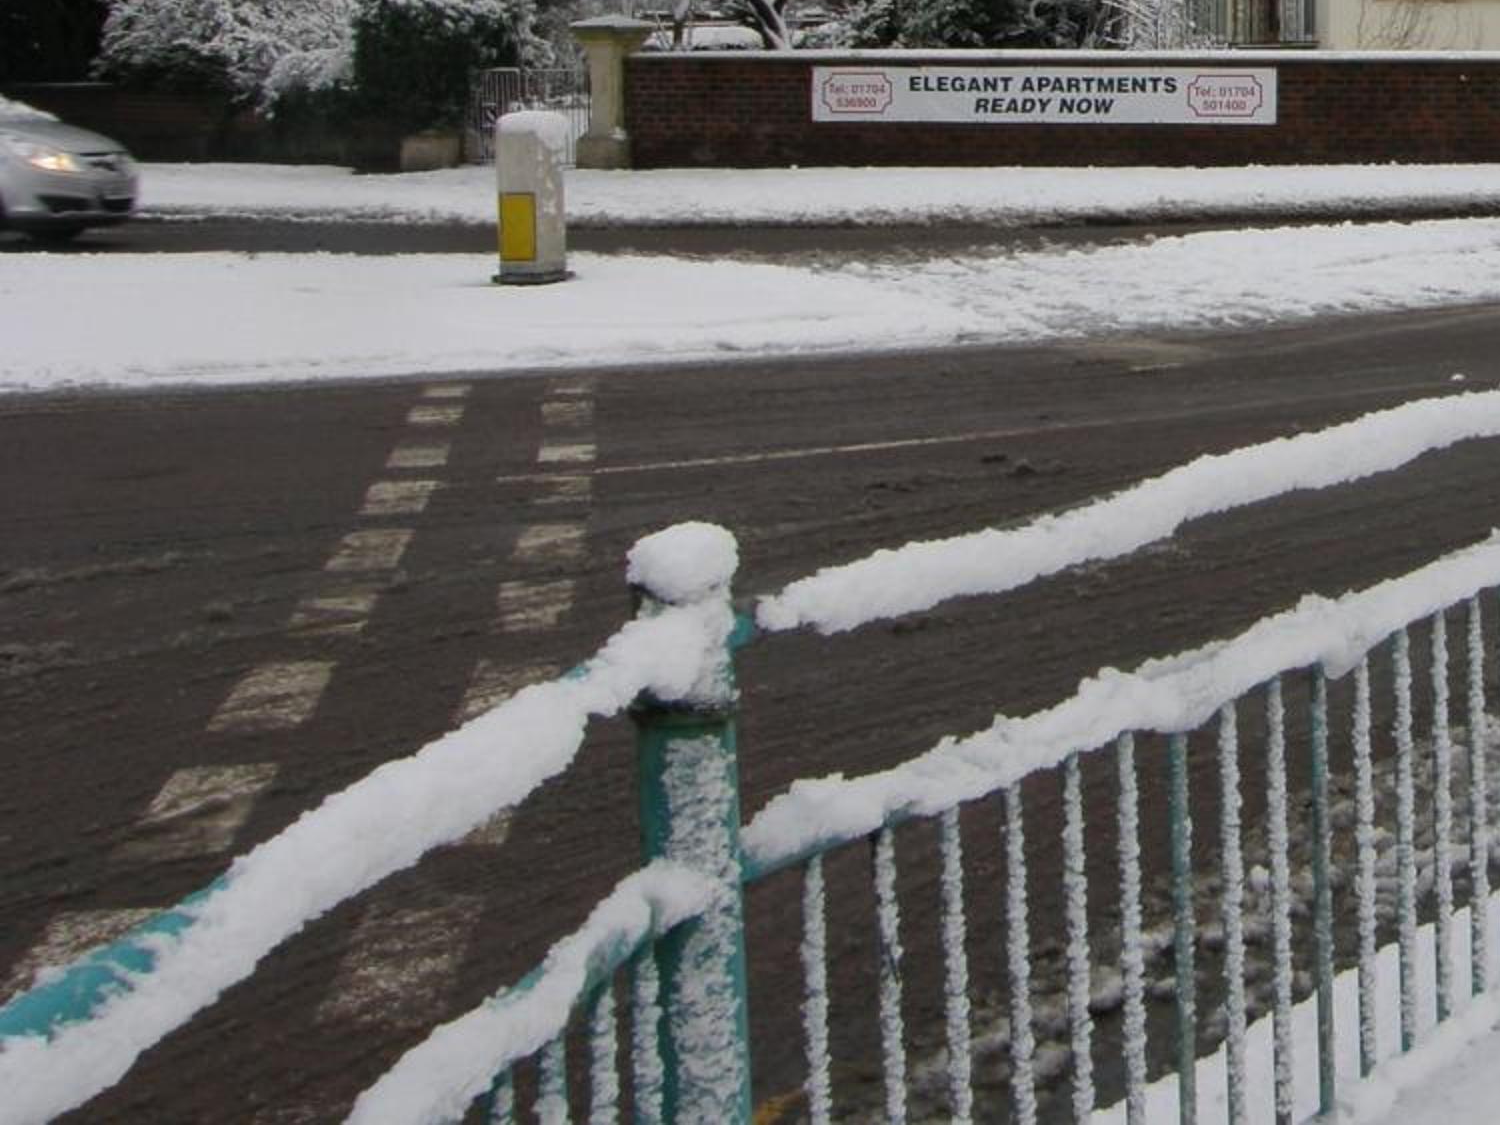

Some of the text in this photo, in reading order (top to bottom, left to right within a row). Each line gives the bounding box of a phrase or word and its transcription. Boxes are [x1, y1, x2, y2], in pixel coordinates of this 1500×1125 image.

[851, 84, 886, 94] 01704
[909, 76, 1178, 94] ELEGANT APARTMENTS
[1194, 85, 1255, 97] Tel: 01704
[974, 98, 1115, 114] READY NOW
